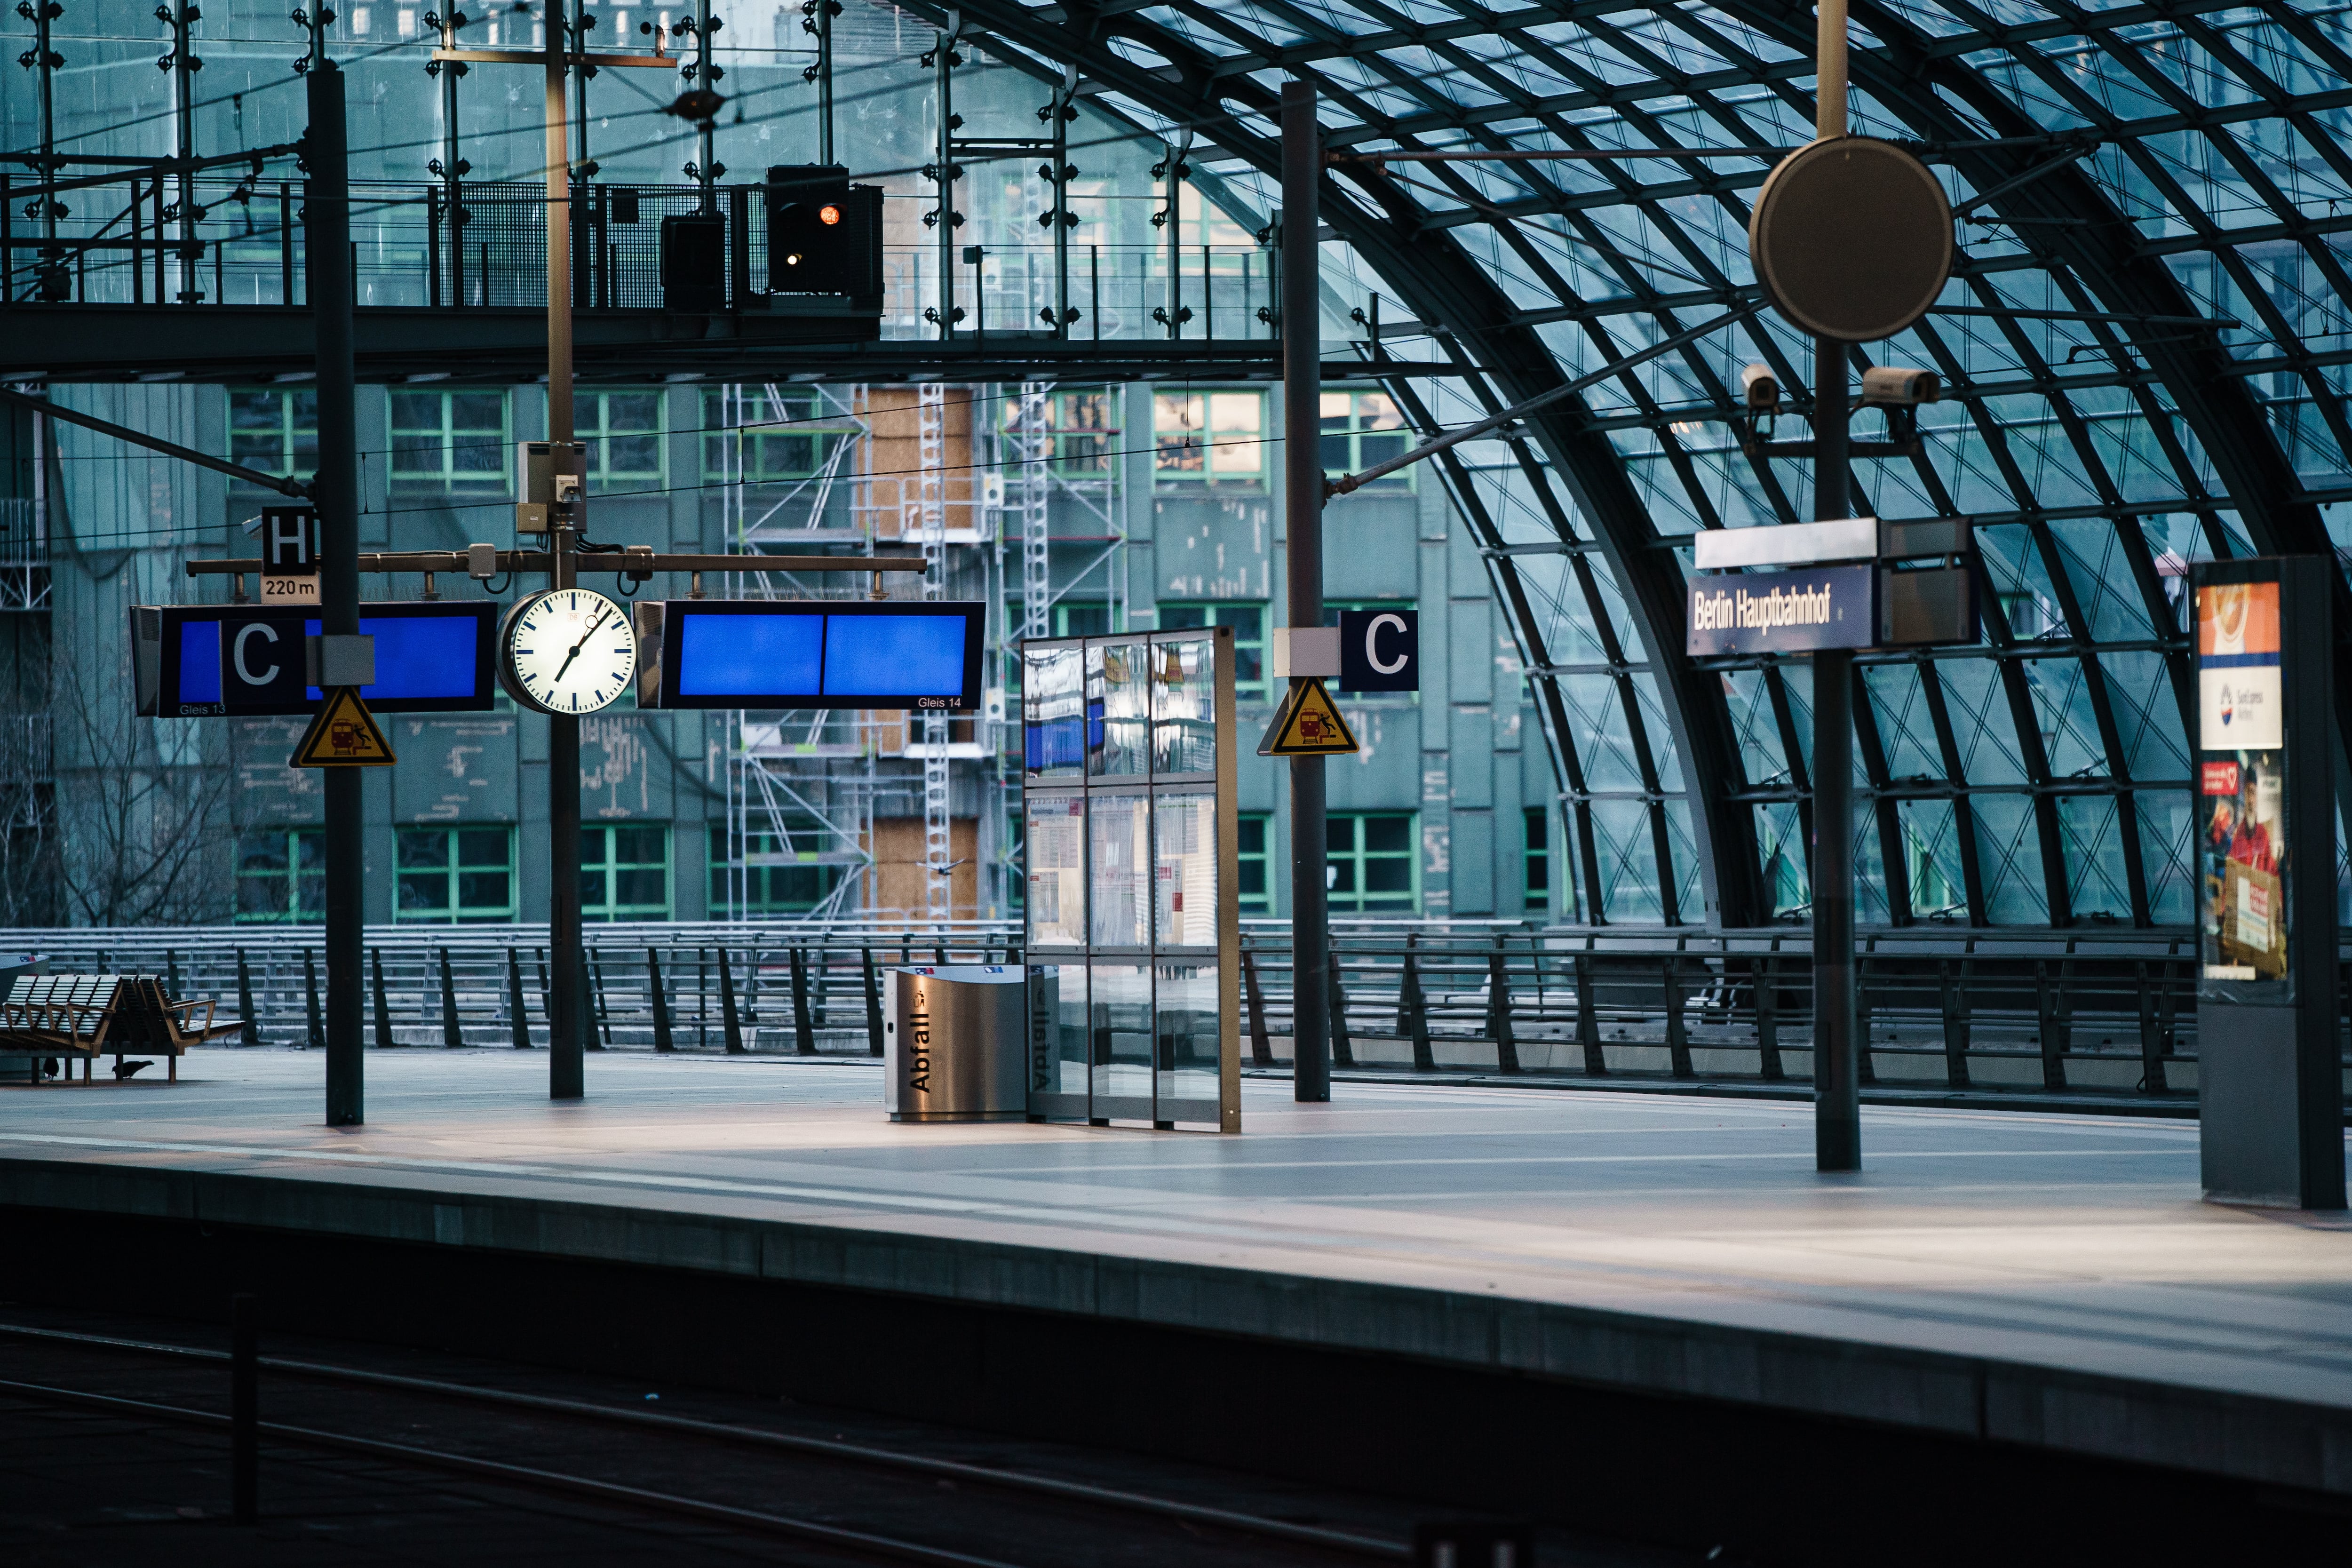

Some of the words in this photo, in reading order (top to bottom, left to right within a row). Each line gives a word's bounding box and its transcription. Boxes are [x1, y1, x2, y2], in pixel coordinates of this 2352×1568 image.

[271, 516, 306, 564] H
[266, 580, 295, 595] 220
[299, 584, 314, 595] m
[1694, 590, 1733, 630] Berlin
[1736, 582, 1831, 637] Hauptbahnhof
[234, 623, 280, 685] C
[1366, 613, 1408, 674] C
[180, 705, 208, 715] Gleis
[213, 704, 225, 714] 13
[918, 697, 945, 708] Gleis
[949, 698, 961, 707] 14
[909, 1013, 930, 1094] Abfall
